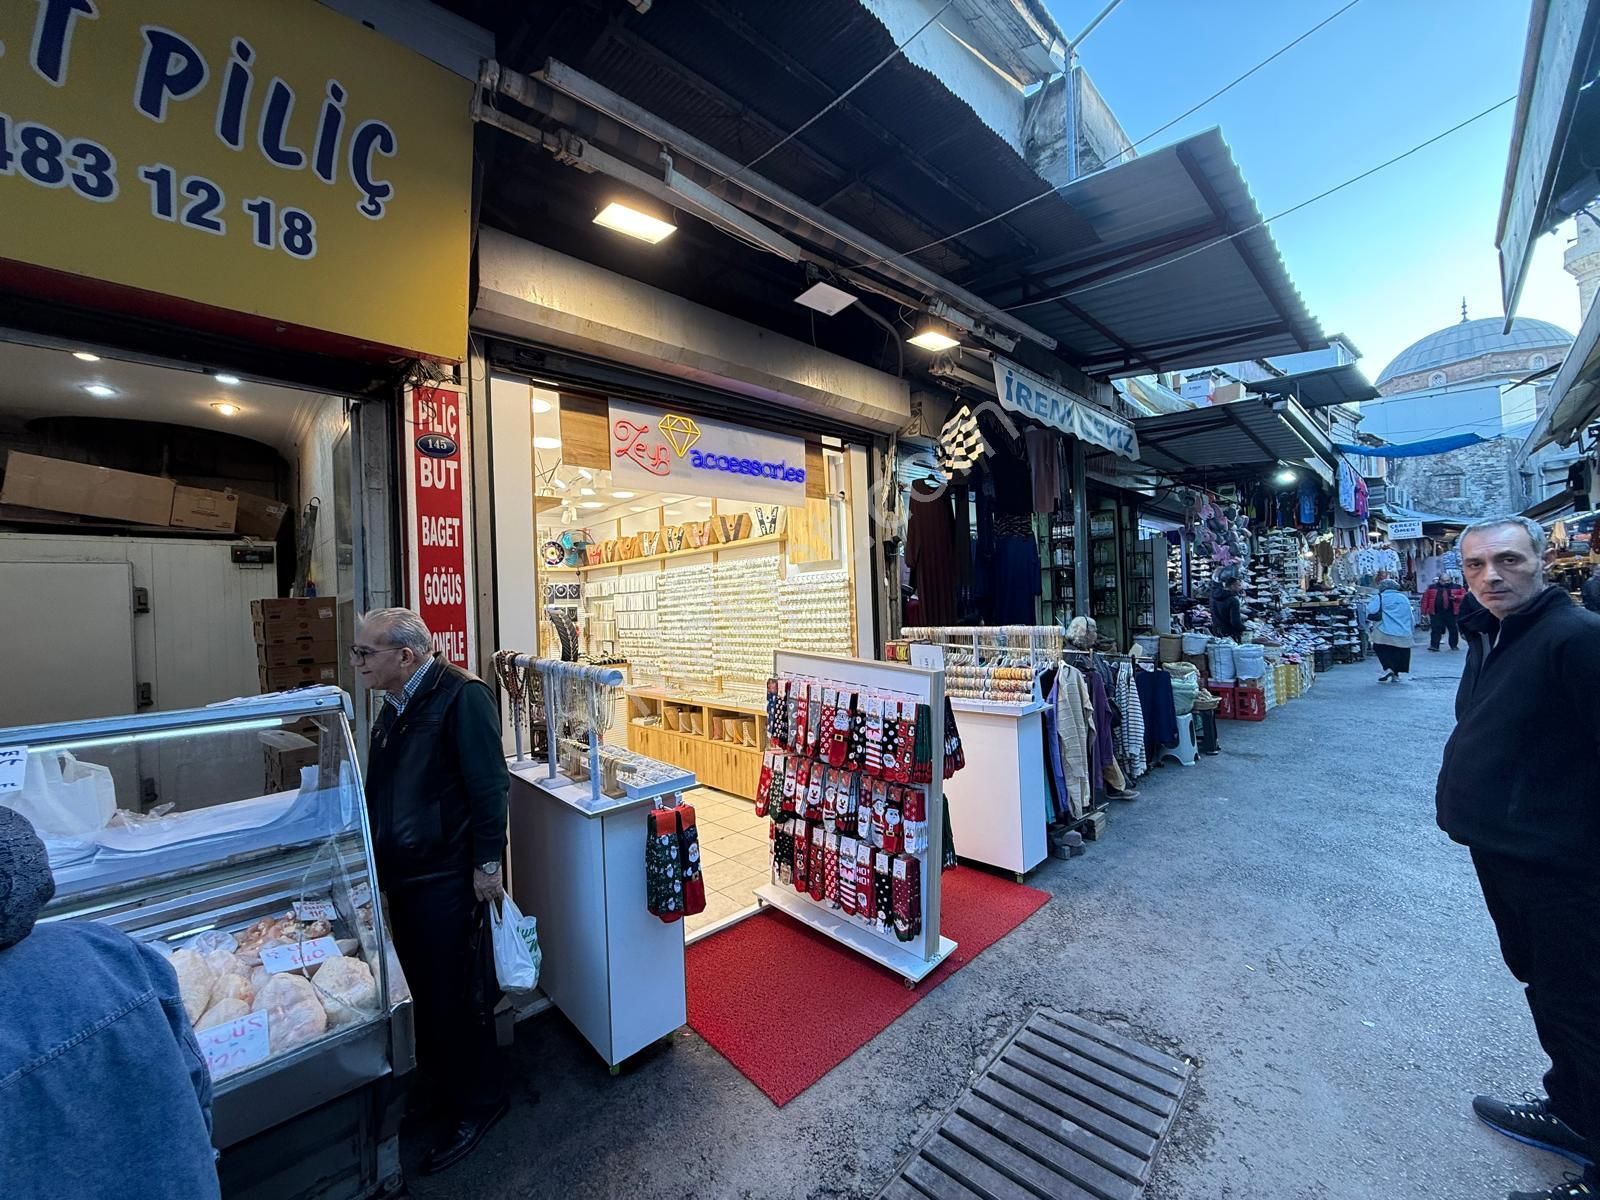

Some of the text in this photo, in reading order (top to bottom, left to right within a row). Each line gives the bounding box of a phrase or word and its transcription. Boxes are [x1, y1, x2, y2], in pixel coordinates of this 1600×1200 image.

[135, 24, 398, 220] PİLİÇ
[138, 162, 227, 236] 12
[242, 196, 318, 260] 18
[418, 394, 457, 440] PİLİÇ
[427, 438, 448, 450] 145
[420, 456, 459, 490] BUT
[689, 448, 806, 484] accessories
[421, 515, 460, 547] BAGET
[423, 566, 463, 606] GÖĞÜS
[431, 623, 465, 662] ONFİLE
[856, 866, 870, 876] HO!
[856, 875, 870, 886] HO!
